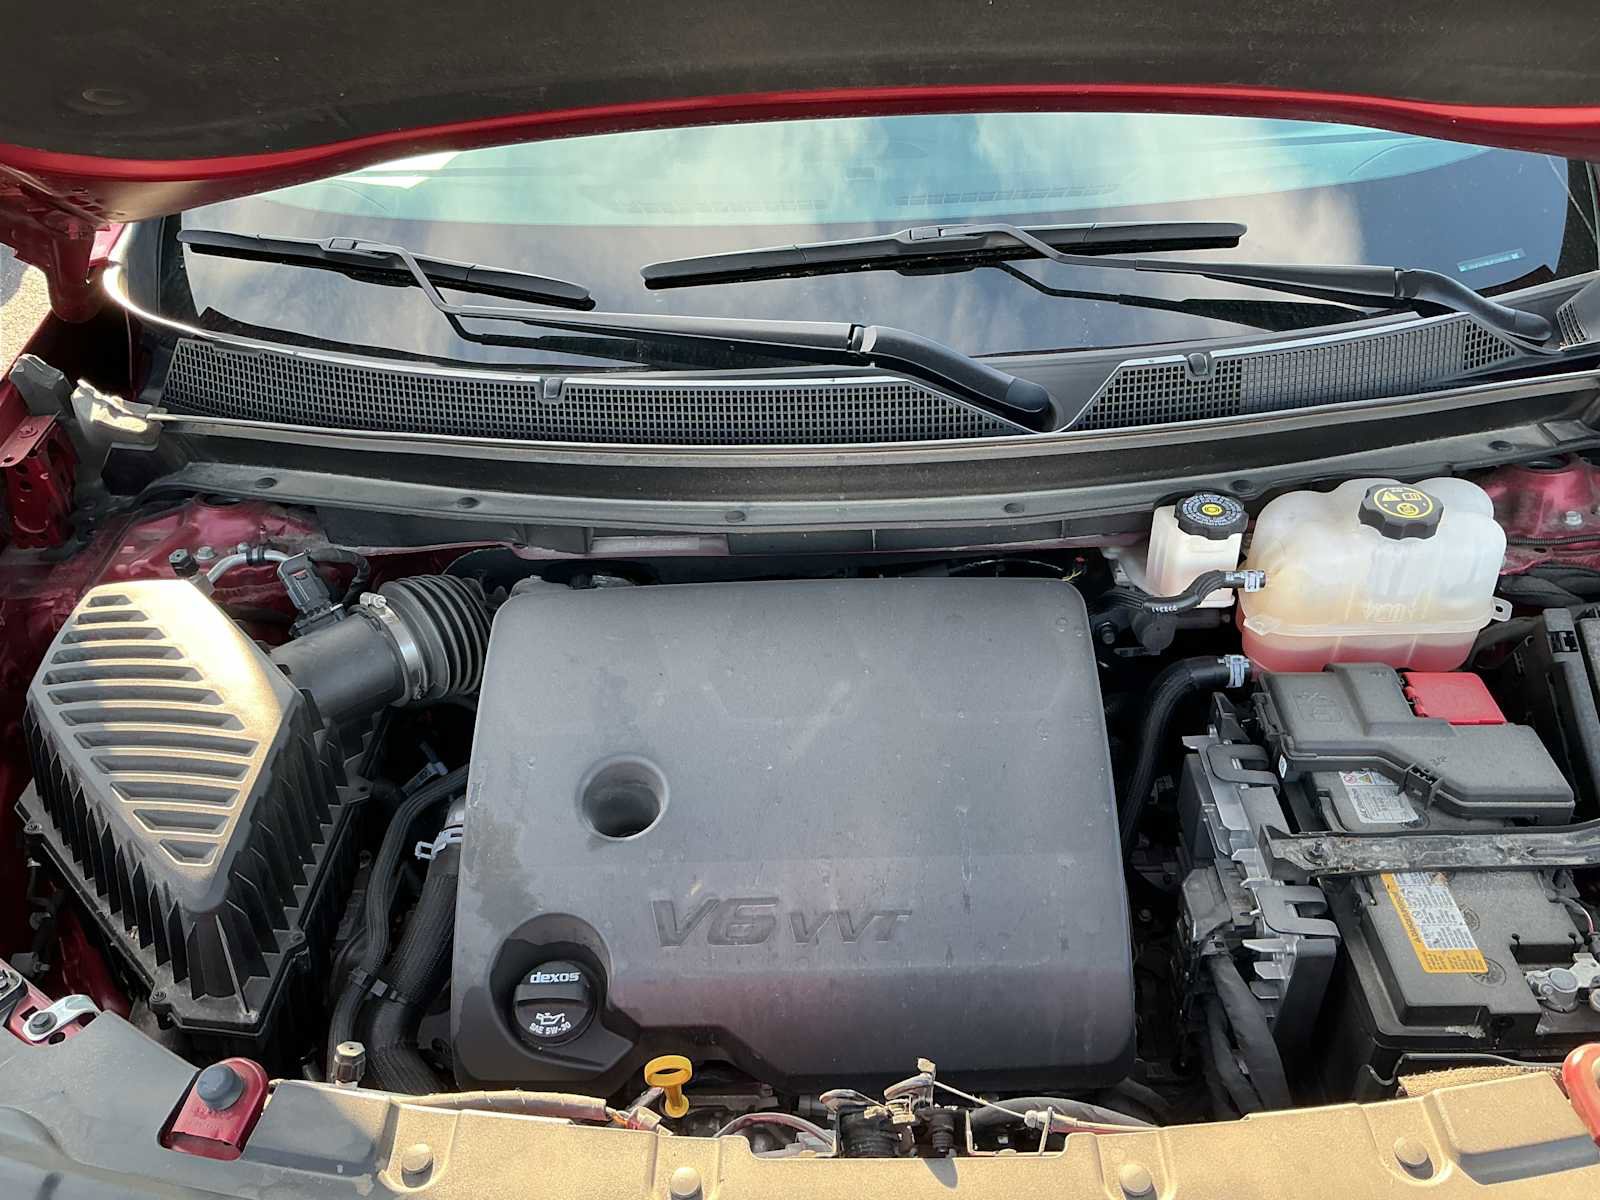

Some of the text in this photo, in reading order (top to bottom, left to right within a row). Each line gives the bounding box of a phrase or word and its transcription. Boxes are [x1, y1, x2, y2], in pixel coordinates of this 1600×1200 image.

[651, 897, 913, 949] V6 VVT
[529, 971, 581, 983] dexos
[529, 1021, 571, 1035] SAE 5W-30
